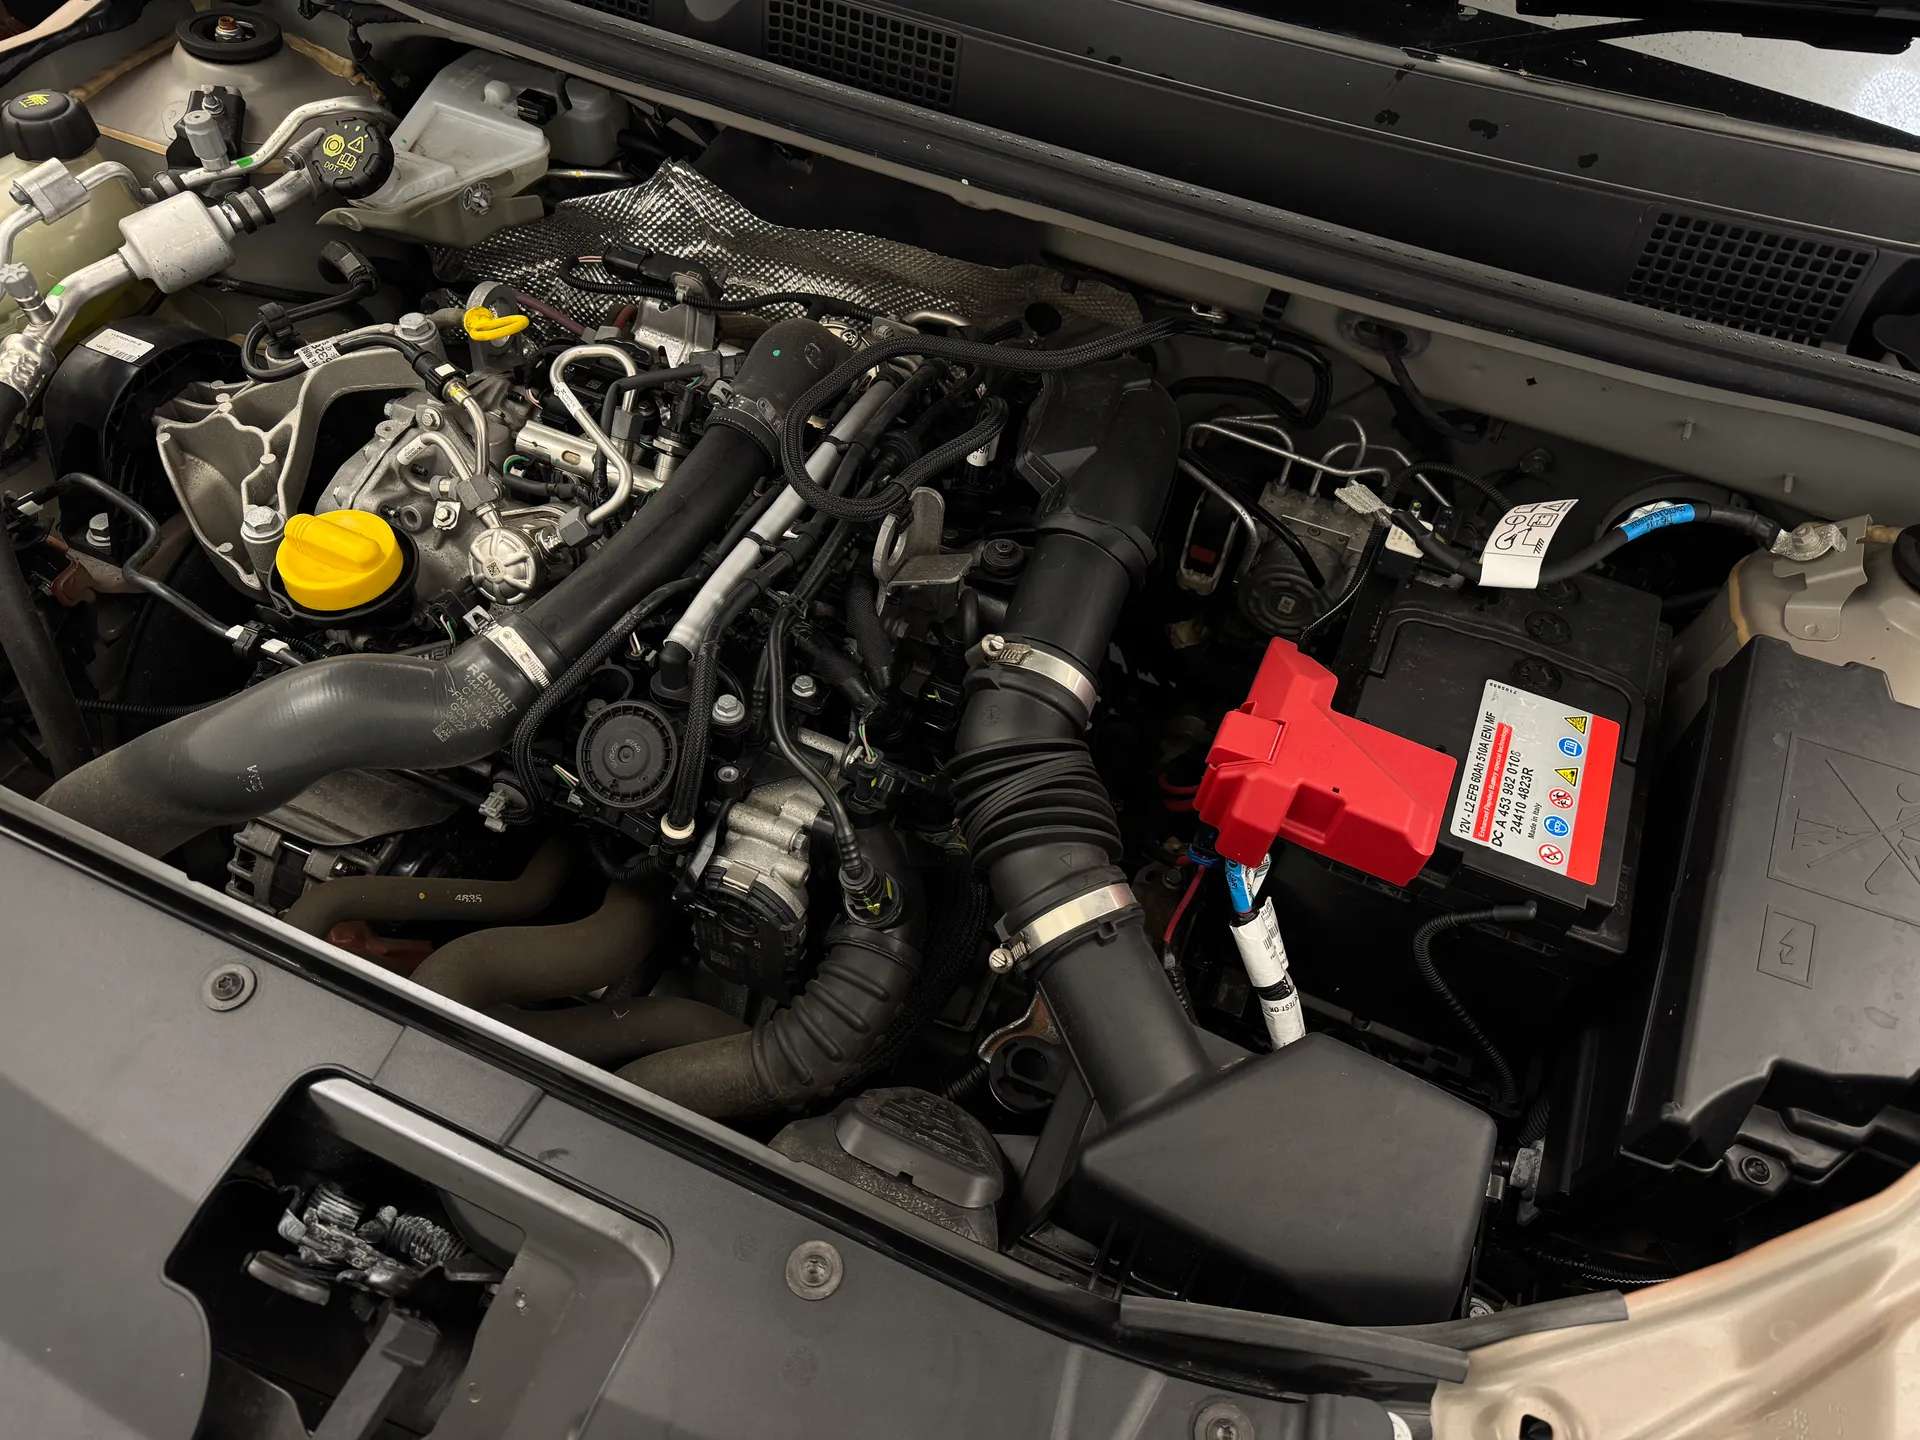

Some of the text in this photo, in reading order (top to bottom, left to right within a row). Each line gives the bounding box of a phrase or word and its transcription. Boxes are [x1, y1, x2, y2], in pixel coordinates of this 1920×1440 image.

[323, 161, 339, 173] DOT
[466, 663, 518, 713] RENAULT
[1484, 711, 1496, 724] MF
[1481, 724, 1496, 742] (EN)
[1498, 726, 1510, 753] technology
[1476, 742, 1490, 762] 510A
[1493, 753, 1504, 771] special
[1470, 762, 1485, 783] 60Ah
[1488, 771, 1499, 790] Battery
[1466, 784, 1479, 802] EFB
[1502, 776, 1516, 796] 982
[1463, 801, 1476, 814] L2
[1498, 797, 1511, 818] 453
[1510, 767, 1534, 834] 24410 4823R
[1459, 817, 1472, 834] 12V
[1478, 811, 1490, 838] Enhanced
[1495, 819, 1507, 829] A
[1528, 823, 1537, 839] Made
[1533, 803, 1542, 817] Italy
[1491, 829, 1504, 847] DC
